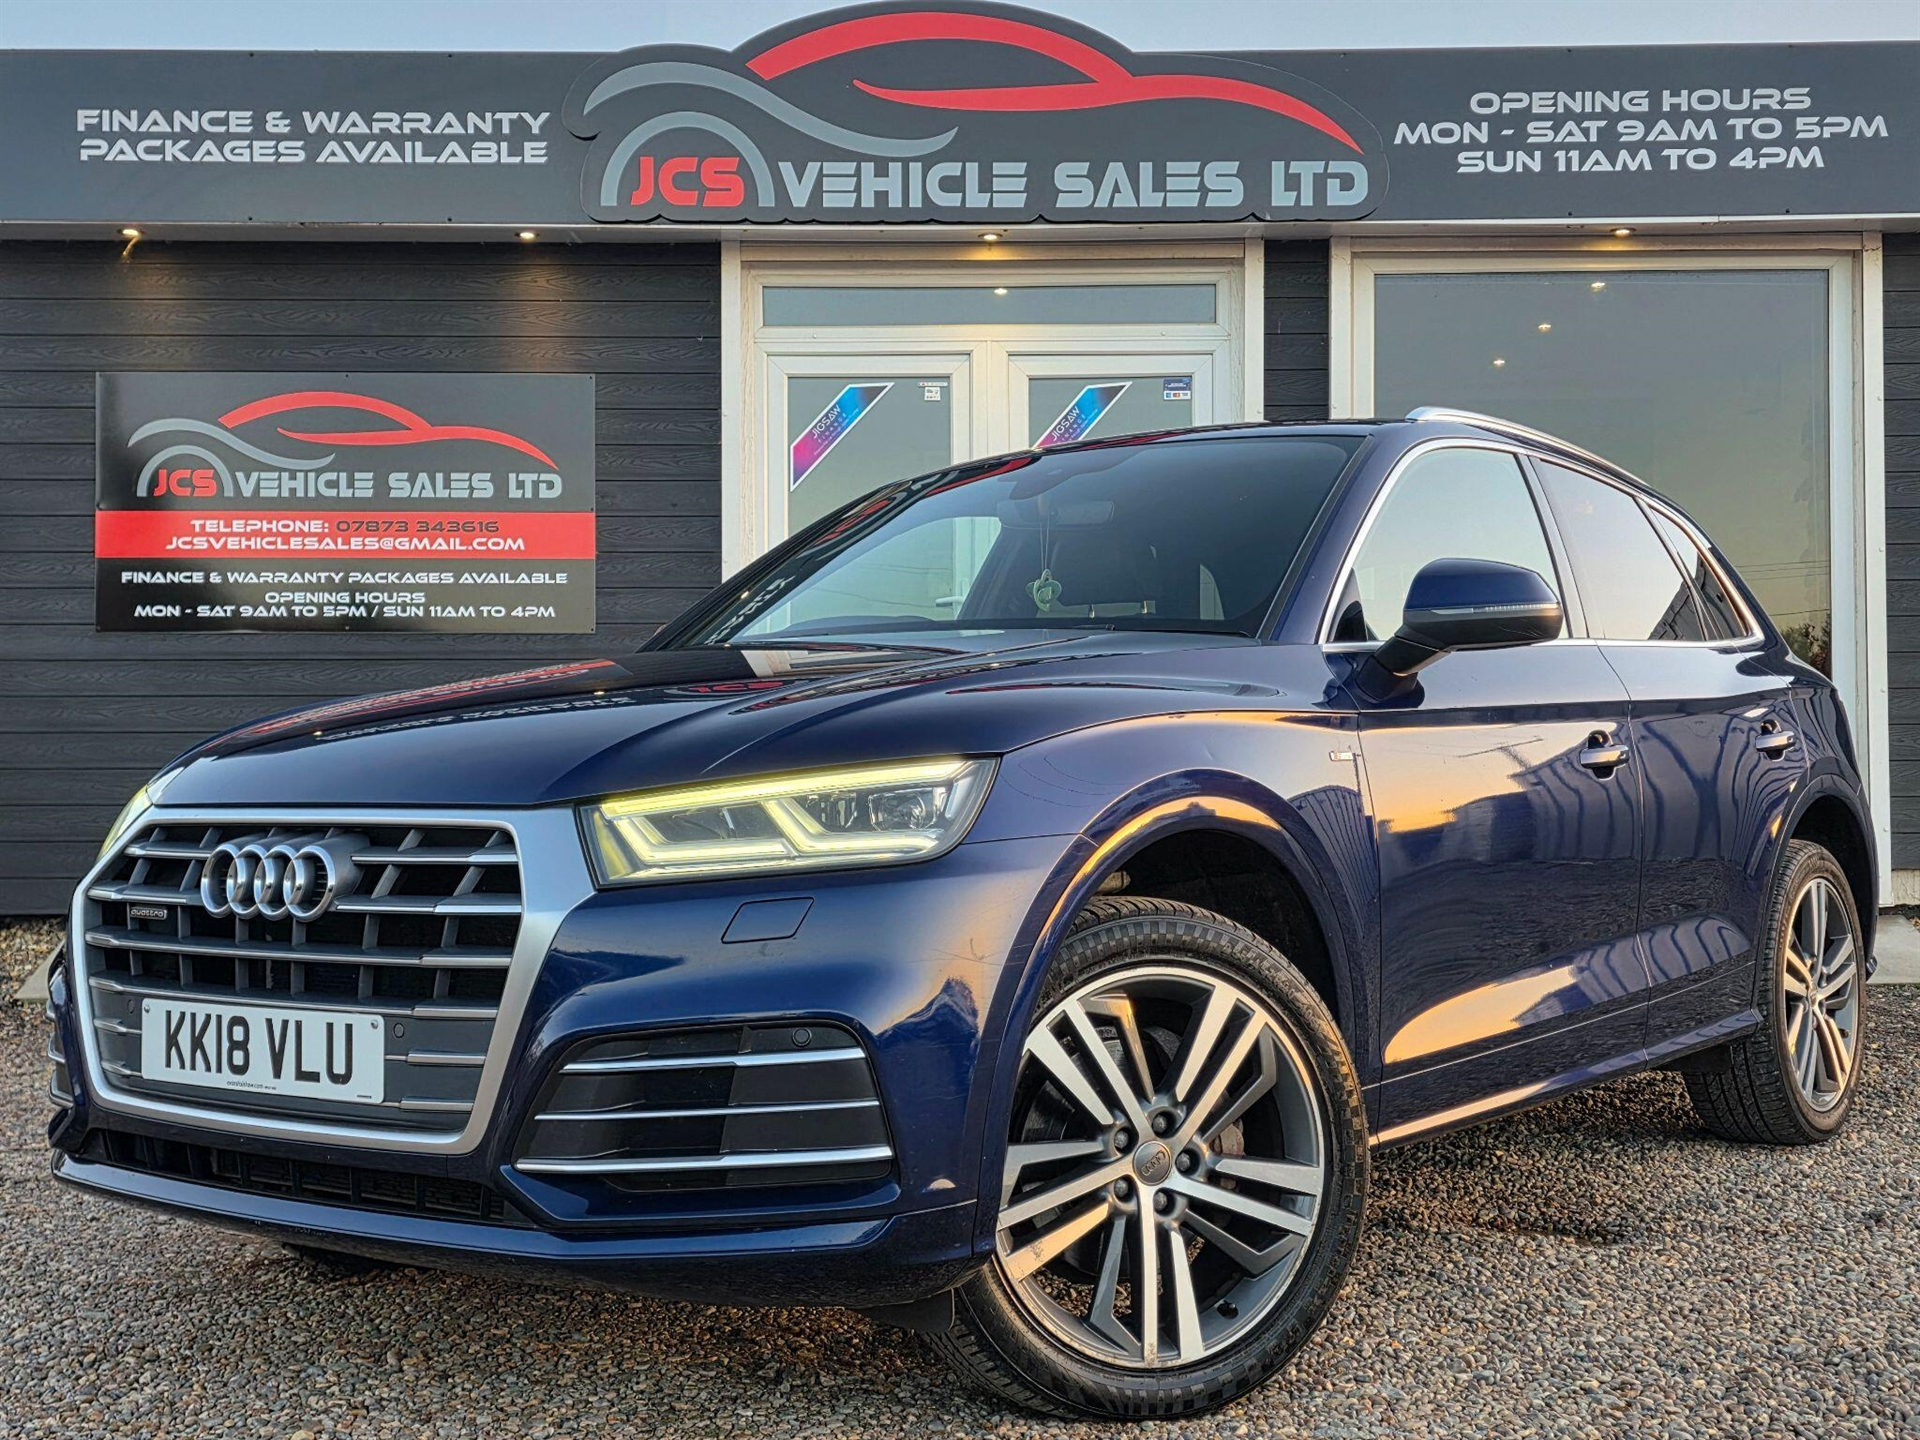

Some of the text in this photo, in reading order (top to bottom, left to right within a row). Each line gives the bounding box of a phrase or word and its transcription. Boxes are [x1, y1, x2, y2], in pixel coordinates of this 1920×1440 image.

[1469, 87, 1812, 115] OPENING HOURS
[76, 109, 551, 135] FINANCE & WARRANTY
[1393, 121, 1489, 145] MON
[1526, 120, 1609, 144] SAT
[1616, 118, 1718, 142] 9AM
[1726, 117, 1783, 140] TO
[1795, 114, 1889, 139] 5PM
[80, 138, 549, 164] PACKAGES AVAILABLE
[1456, 145, 1825, 173] SUN 11AM TO 4PM
[630, 156, 1369, 208] JCS VEHICLE SALES LTD
[811, 404, 841, 439] JIGSAW
[1051, 405, 1080, 441] JIGSAW
[153, 469, 563, 499] JCS VEHICLE SALES LTD
[190, 519, 500, 533] TELEPHONE: 07873 343616
[165, 536, 525, 551] JCSVEHICLESALES@GMAIL.COM
[121, 571, 568, 585] FINANCE & WARRANTY PACKAGES AVAILABLE
[264, 591, 426, 604] OPENING HOURS
[134, 605, 180, 617] MON
[196, 605, 236, 617] SAT
[240, 605, 288, 617] 9AM
[290, 605, 318, 617] TO
[323, 605, 367, 617] 5PM
[382, 605, 424, 618] SUN
[428, 605, 476, 618] 11AM
[478, 605, 507, 618] TO
[510, 605, 556, 618] 4PM
[130, 909, 164, 918] quattro
[165, 1010, 353, 1085] KK18 VLU
